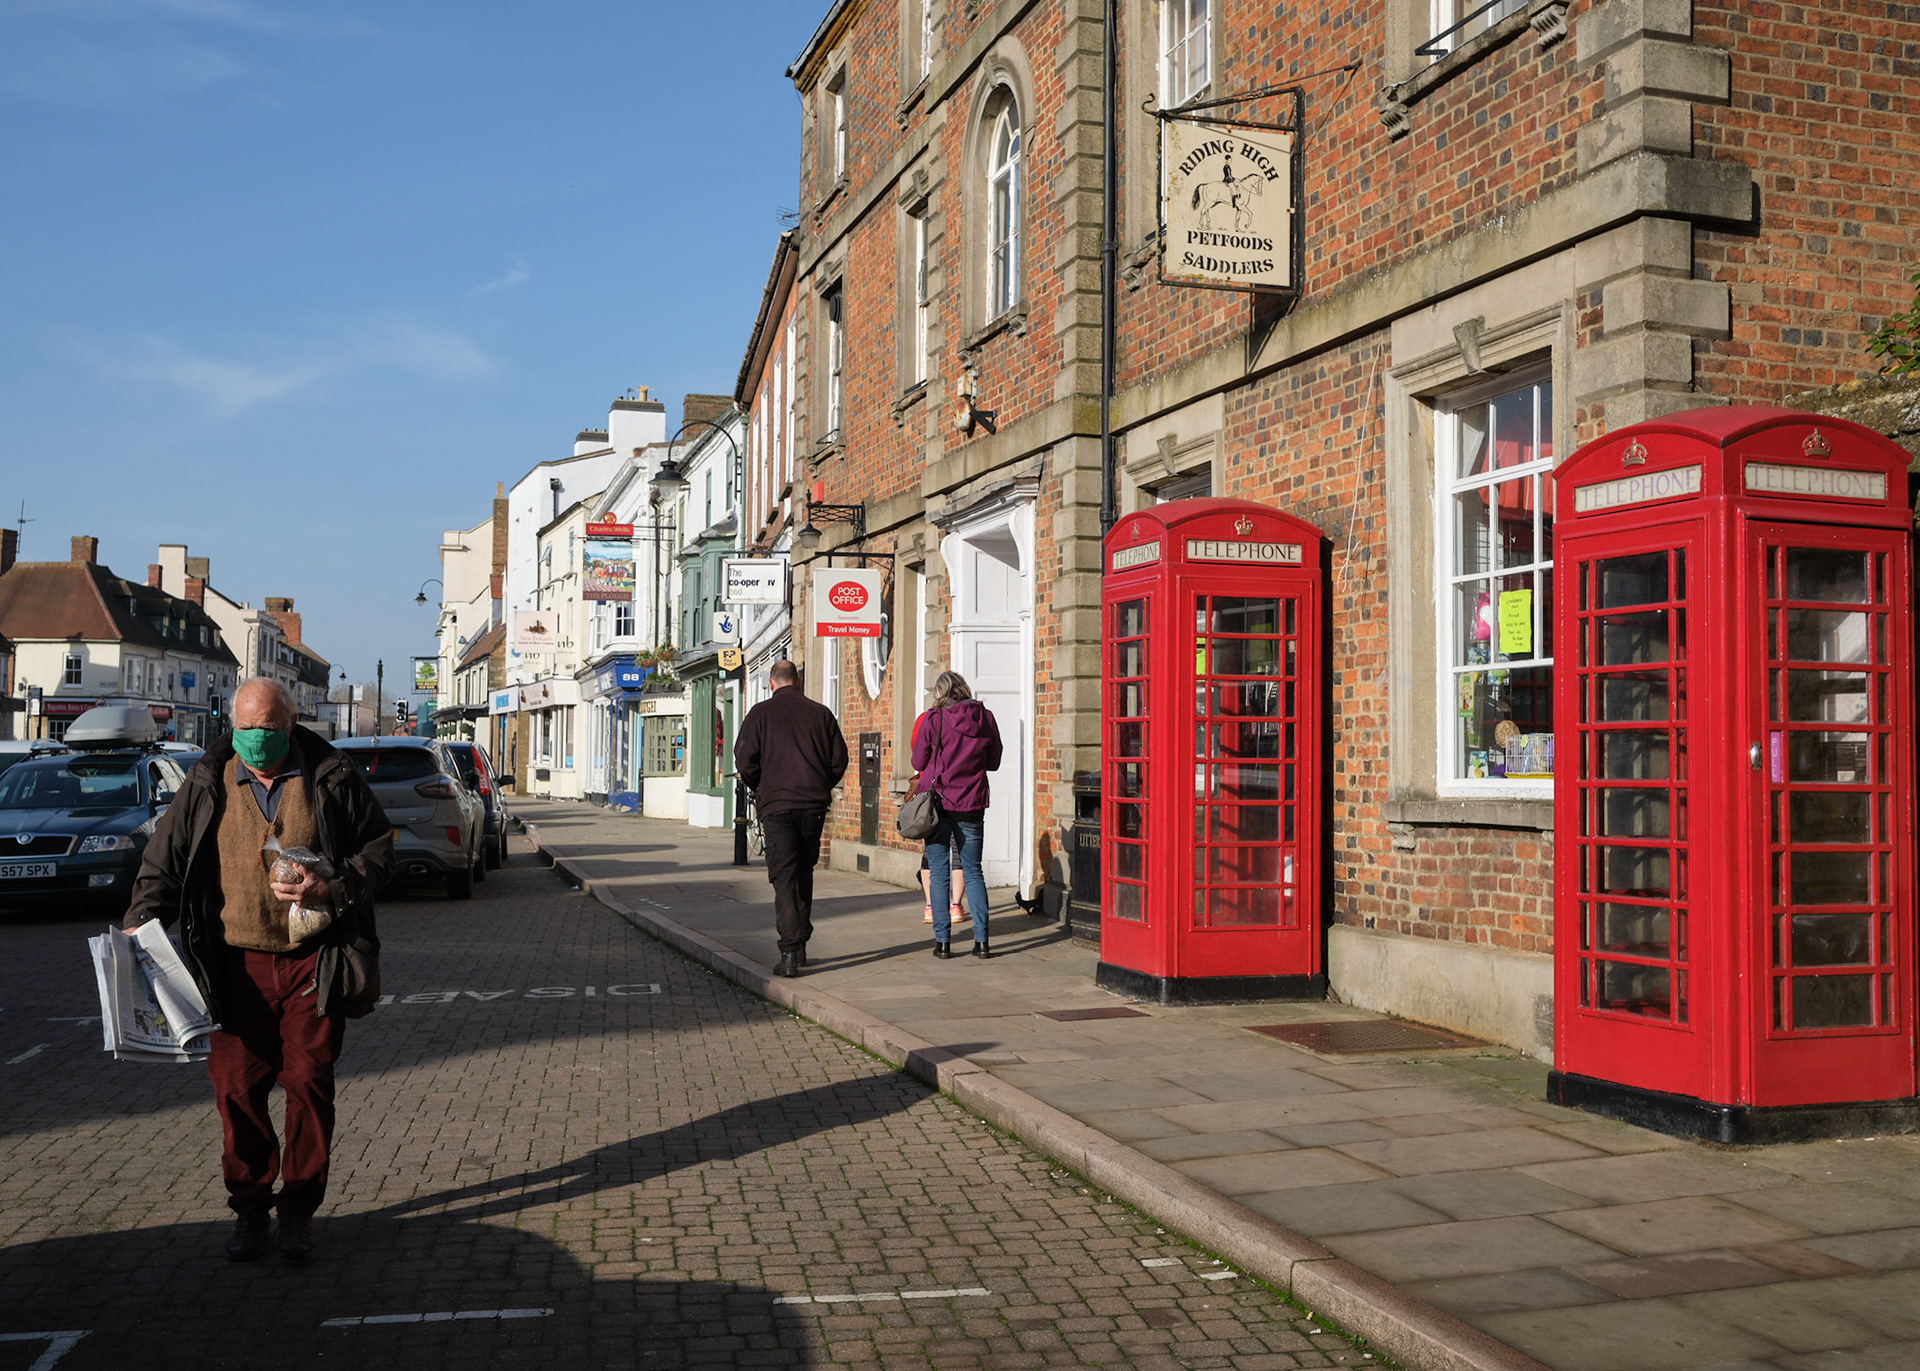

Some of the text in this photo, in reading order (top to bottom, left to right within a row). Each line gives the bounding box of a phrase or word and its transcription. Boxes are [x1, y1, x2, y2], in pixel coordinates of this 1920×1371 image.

[1179, 140, 1279, 182] RIDING HIGH
[1187, 230, 1273, 251] PETFOODS
[1183, 251, 1274, 274] SADDLERS
[1580, 468, 1698, 508] TELEPHONE
[1747, 465, 1880, 497] TELEPHONE
[1115, 543, 1159, 567] TELEPHONE
[1190, 540, 1298, 560] TELEPHONE
[832, 596, 864, 605] OFFICE
[837, 587, 861, 596] POST
[827, 625, 870, 635] Travel Money
[622, 673, 640, 681] 98
[26, 864, 49, 876] SPX
